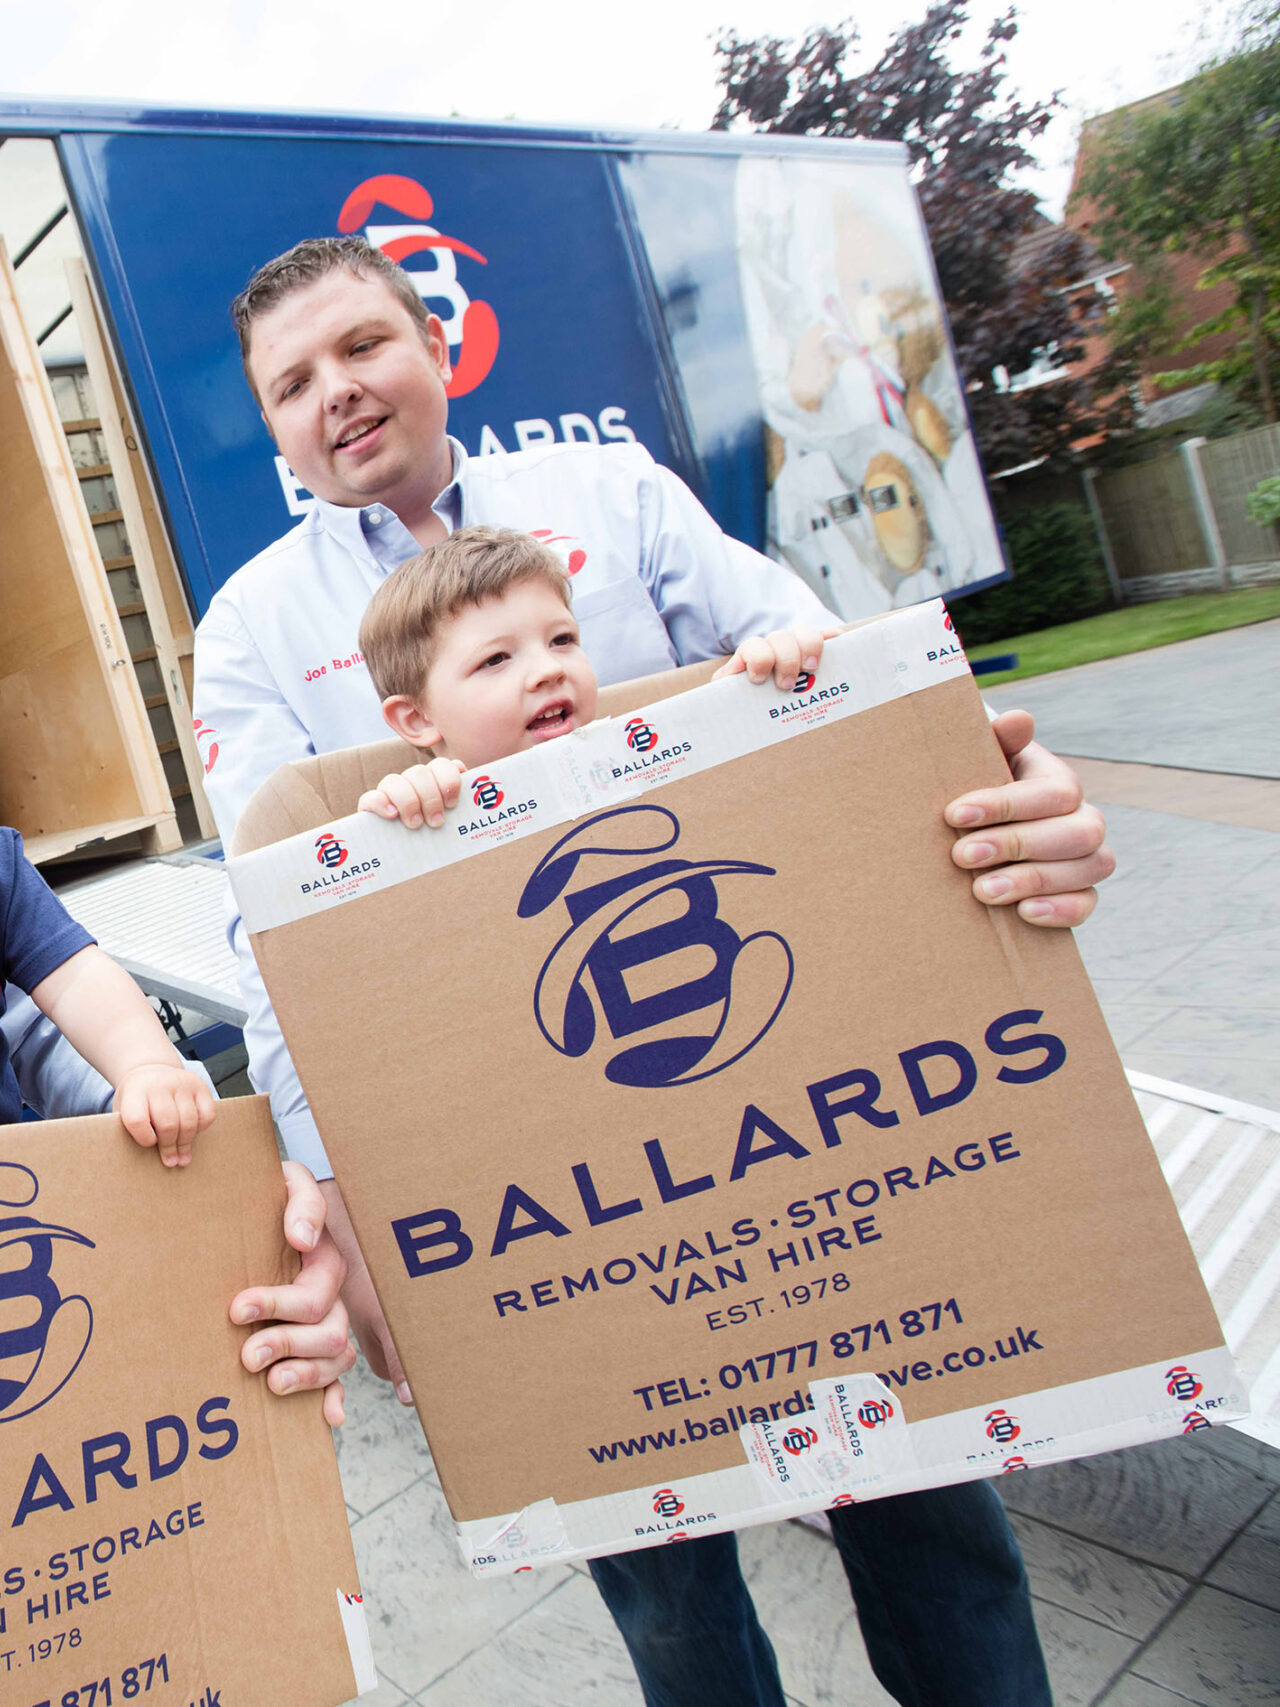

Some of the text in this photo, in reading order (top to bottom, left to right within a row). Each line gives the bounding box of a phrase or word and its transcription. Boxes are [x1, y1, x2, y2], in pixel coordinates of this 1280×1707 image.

[305, 665, 327, 682] Joe
[769, 682, 850, 719] BALLARDS
[612, 741, 692, 778] BALLARDS
[458, 799, 538, 836] BALLARDS
[301, 858, 381, 893] BALLARDS
[391, 1009, 1067, 1278] BALLARDS
[650, 1215, 883, 1305] VAN HIRE
[707, 1273, 851, 1331] EST. 1978
[634, 1297, 964, 1411] TEL: 01777 871 871
[835, 1384, 864, 1457] BALLARDS
[762, 1423, 790, 1483] ALLARDS
[634, 1512, 718, 1537] BALLARDS
[27, 1572, 111, 1624] HIRE
[28, 1628, 83, 1662] 1978
[121, 1653, 169, 1699] 871
